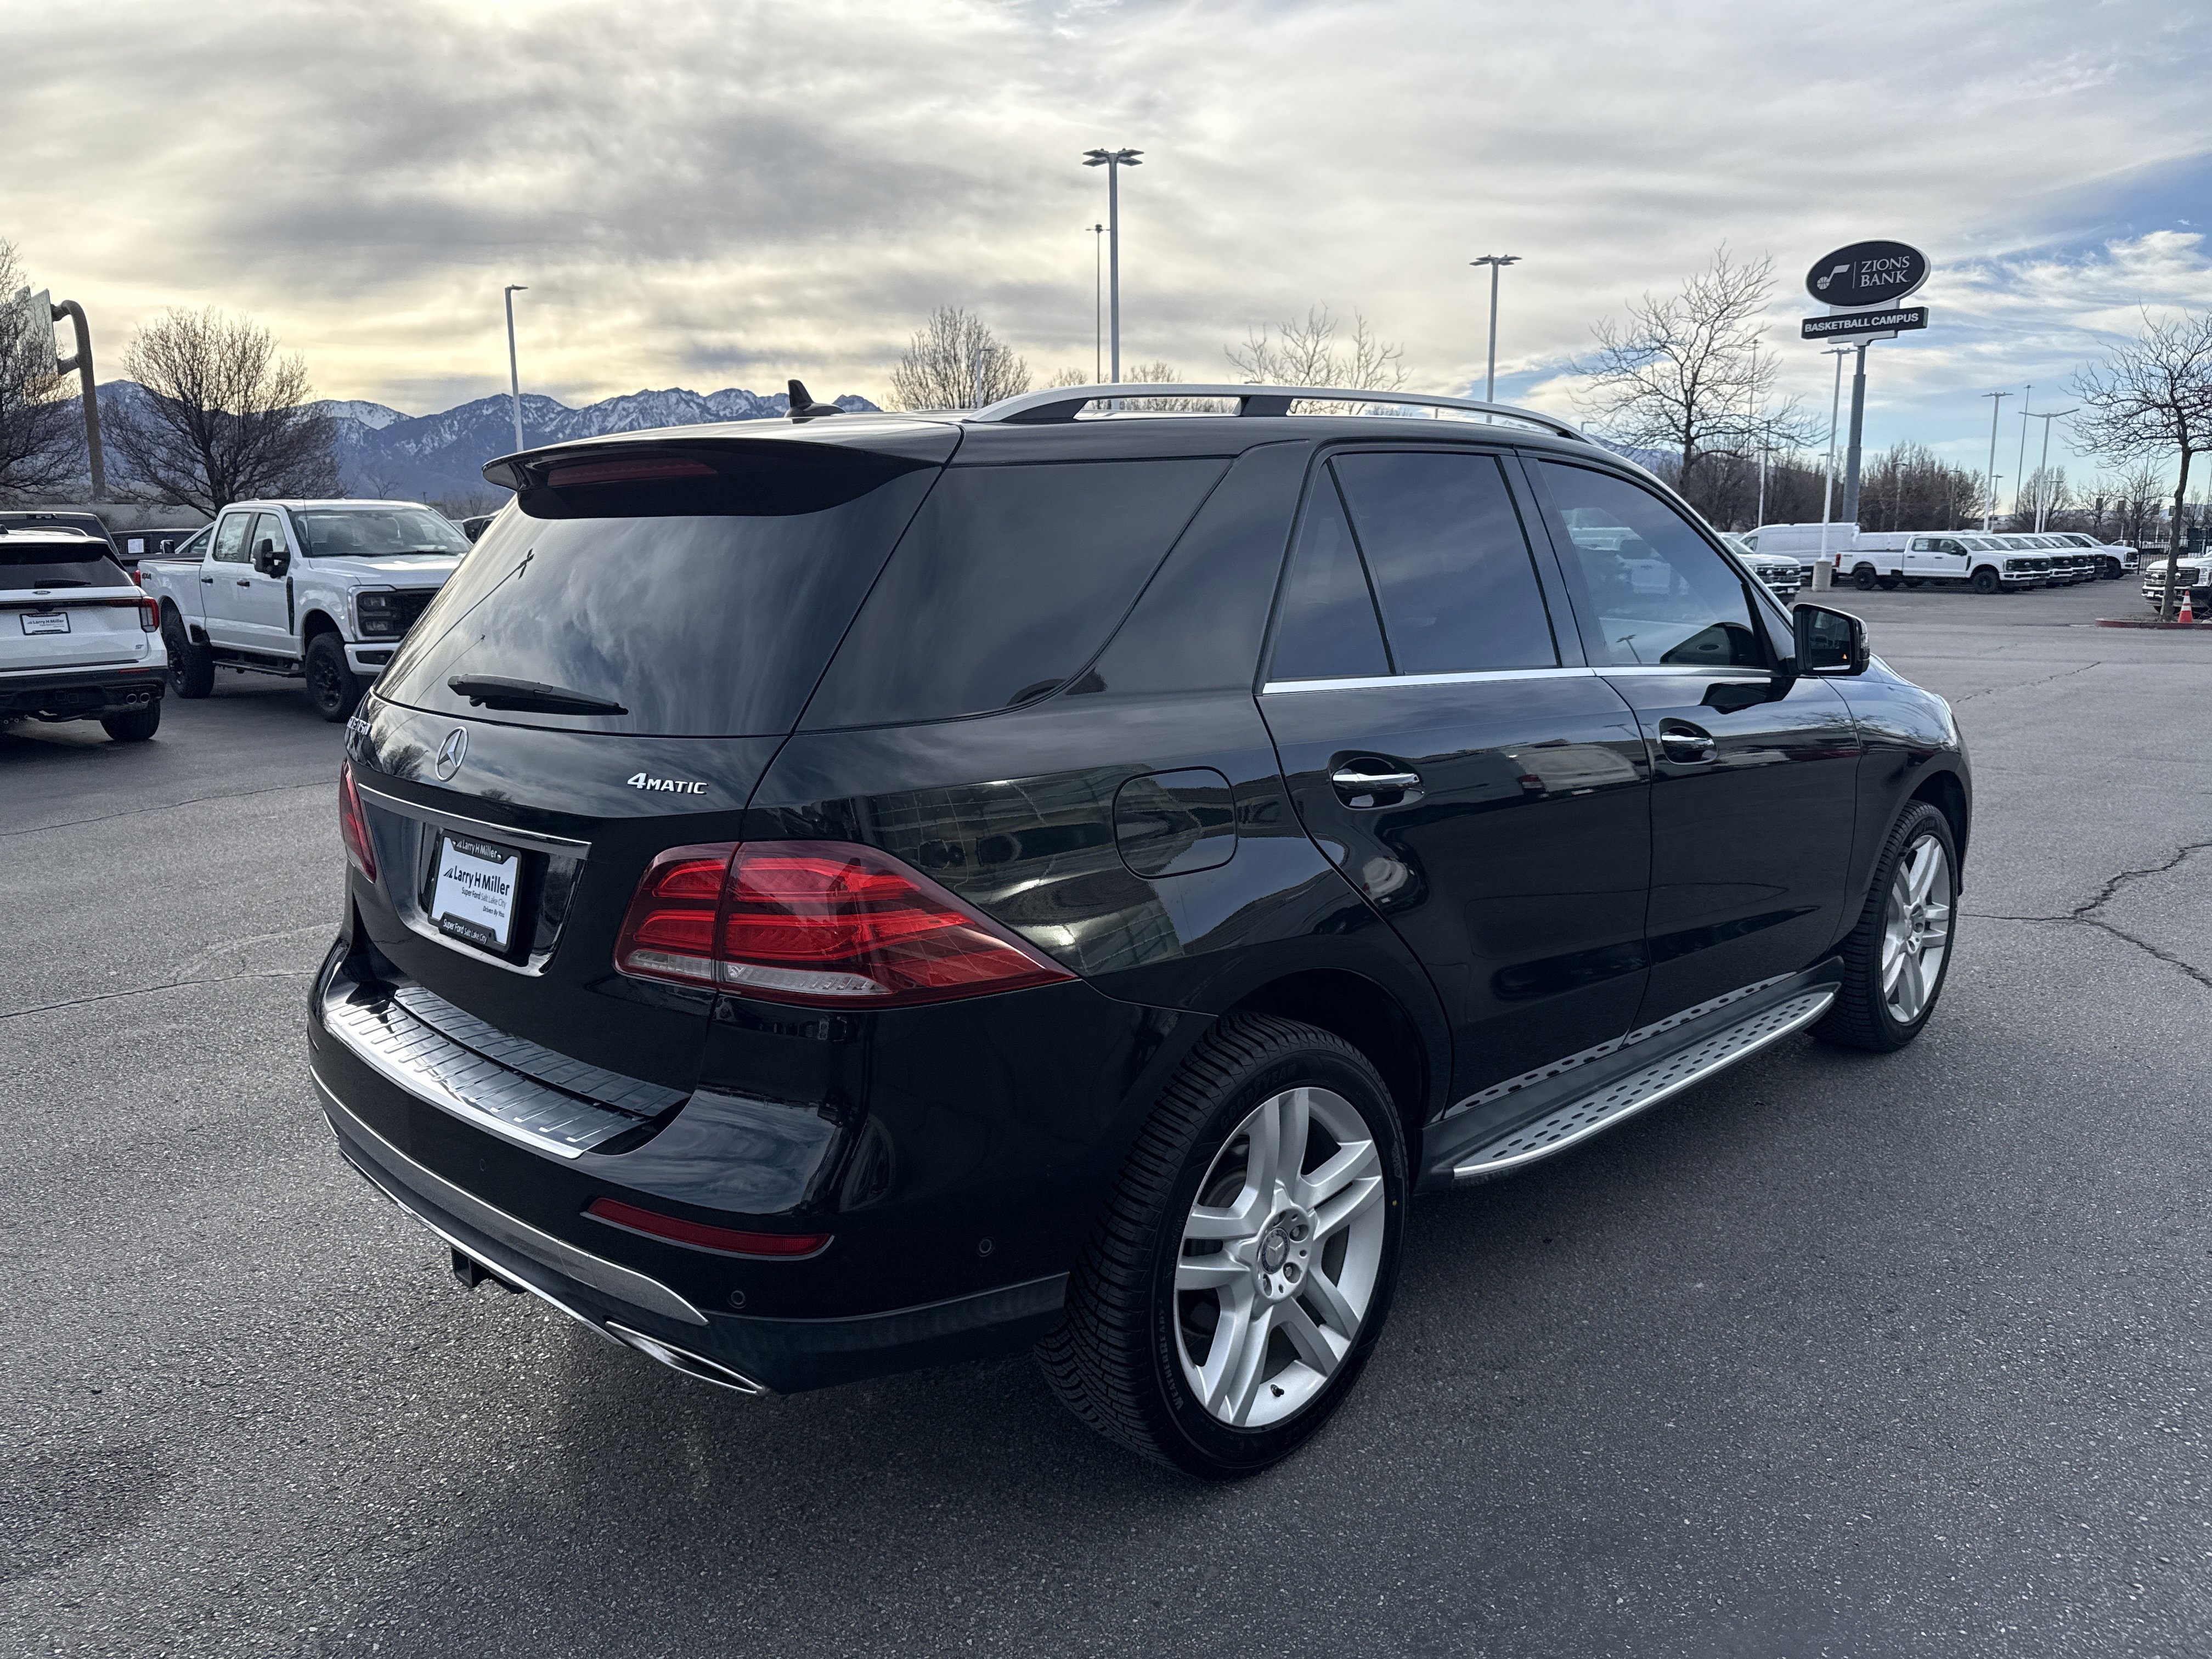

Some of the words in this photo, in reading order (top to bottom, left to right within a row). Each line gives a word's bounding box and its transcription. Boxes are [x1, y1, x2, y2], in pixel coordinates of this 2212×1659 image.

[1860, 256, 1910, 273] ZIONS
[1860, 270, 1909, 287] BANK
[1804, 318, 1871, 332] BASKETBALL
[1871, 313, 1919, 326] CAMPUS
[627, 772, 708, 794] 4MATIC
[462, 839, 475, 854] Larry
[475, 843, 481, 853] H
[480, 844, 498, 858] Miller
[454, 865, 474, 888] Larry
[474, 872, 481, 888] H
[482, 874, 510, 895] Miller
[472, 890, 481, 900] Ford
[488, 895, 498, 905] Lake
[498, 899, 507, 909] City
[443, 918, 455, 930] Super
[454, 922, 465, 934] Ford
[471, 930, 479, 940] Lake
